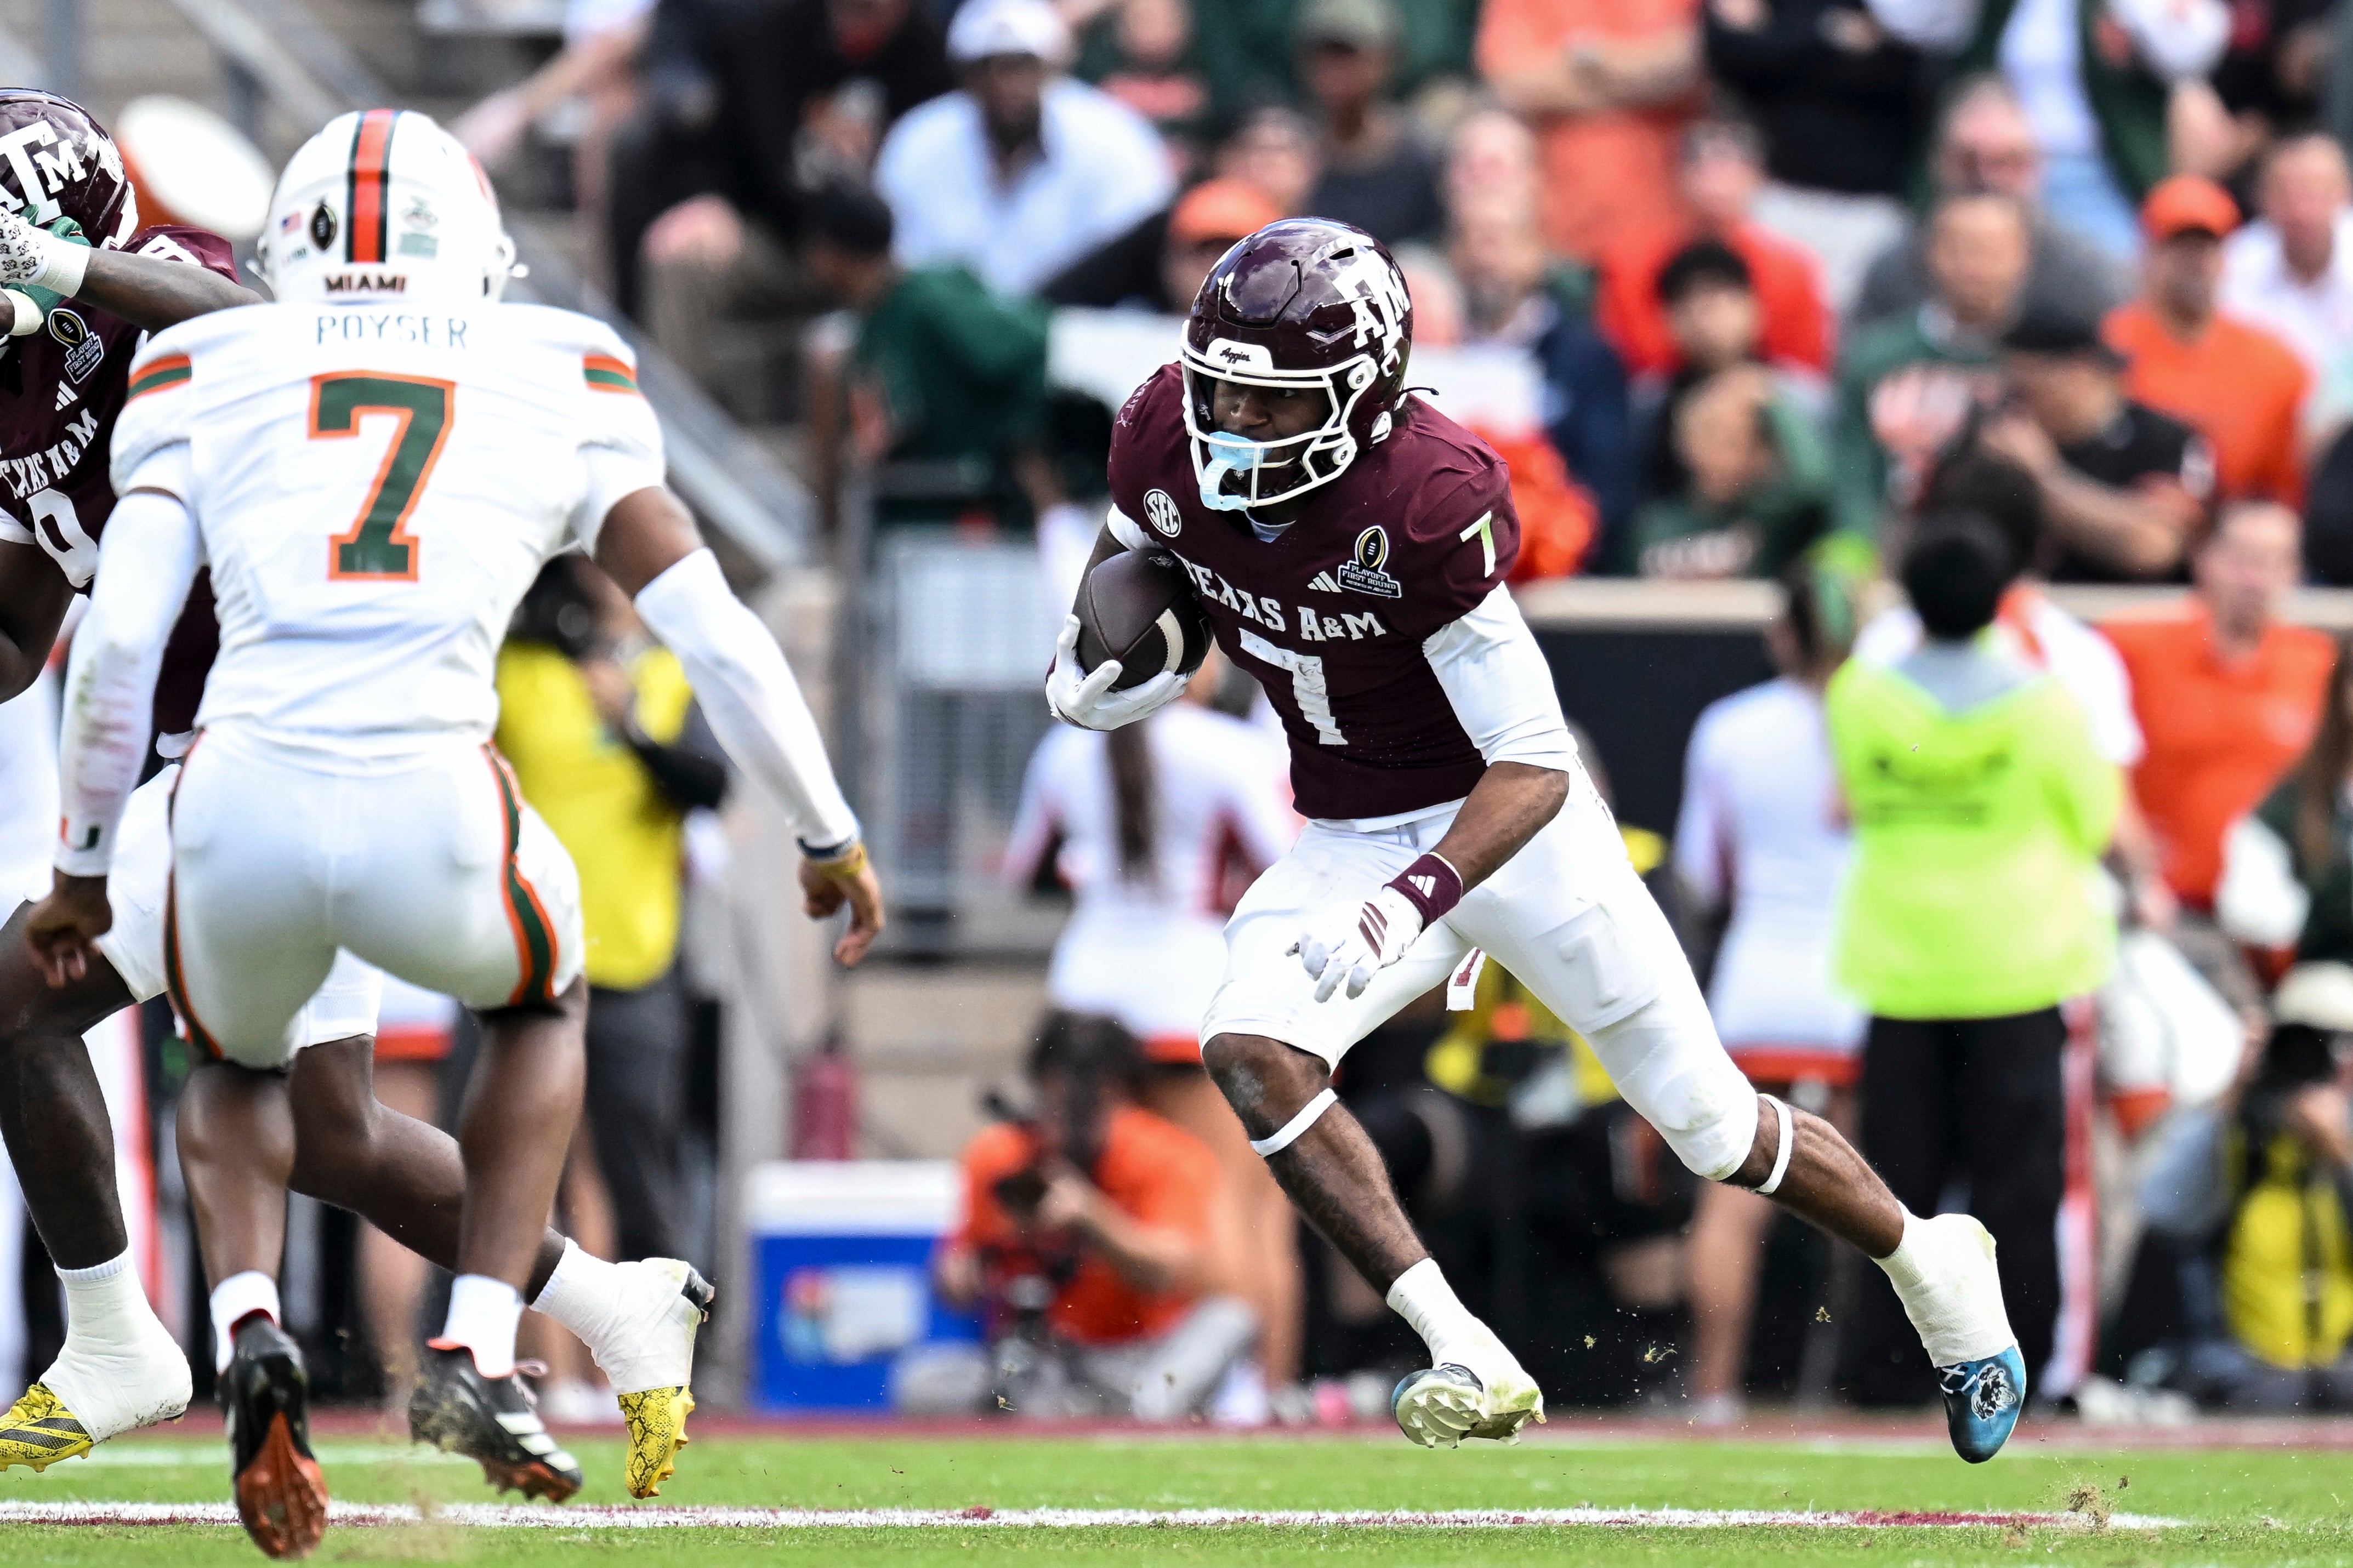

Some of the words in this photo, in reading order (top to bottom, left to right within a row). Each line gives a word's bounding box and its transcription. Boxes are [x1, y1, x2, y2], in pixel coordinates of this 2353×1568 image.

[325, 275, 407, 292] MIAMI
[70, 337, 93, 361] PLAYOFF
[317, 315, 467, 349] POYSER
[69, 355, 85, 373] FIRST
[1219, 347, 1251, 364] Aggies
[45, 408, 98, 480] A&M
[307, 369, 456, 582] 7
[1147, 493, 1178, 533] SEC
[1459, 510, 1496, 578] 7
[1342, 570, 1366, 582] FIRST
[1368, 578, 1396, 590] ROUND
[1351, 565, 1386, 581] PLAYOFF
[1297, 606, 1386, 641] A&M
[1238, 627, 1349, 745] 7
